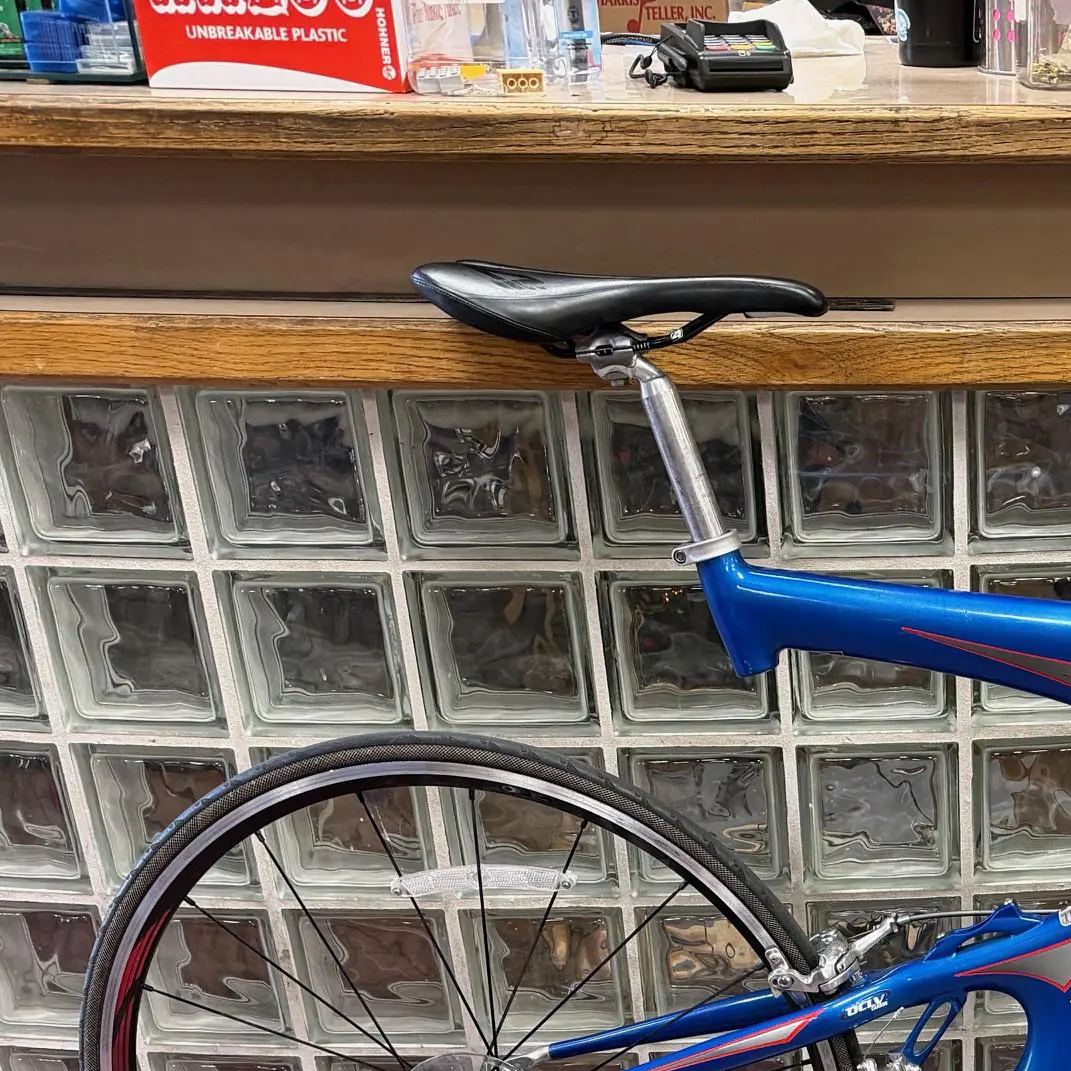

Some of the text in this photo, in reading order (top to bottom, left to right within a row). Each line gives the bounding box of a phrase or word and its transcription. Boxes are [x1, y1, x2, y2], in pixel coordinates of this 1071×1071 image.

[644, 6, 716, 22] TELLER, INC.
[185, 25, 348, 43] UNBREAKABLE PLASTIC
[375, 8, 393, 65] HOHNER
